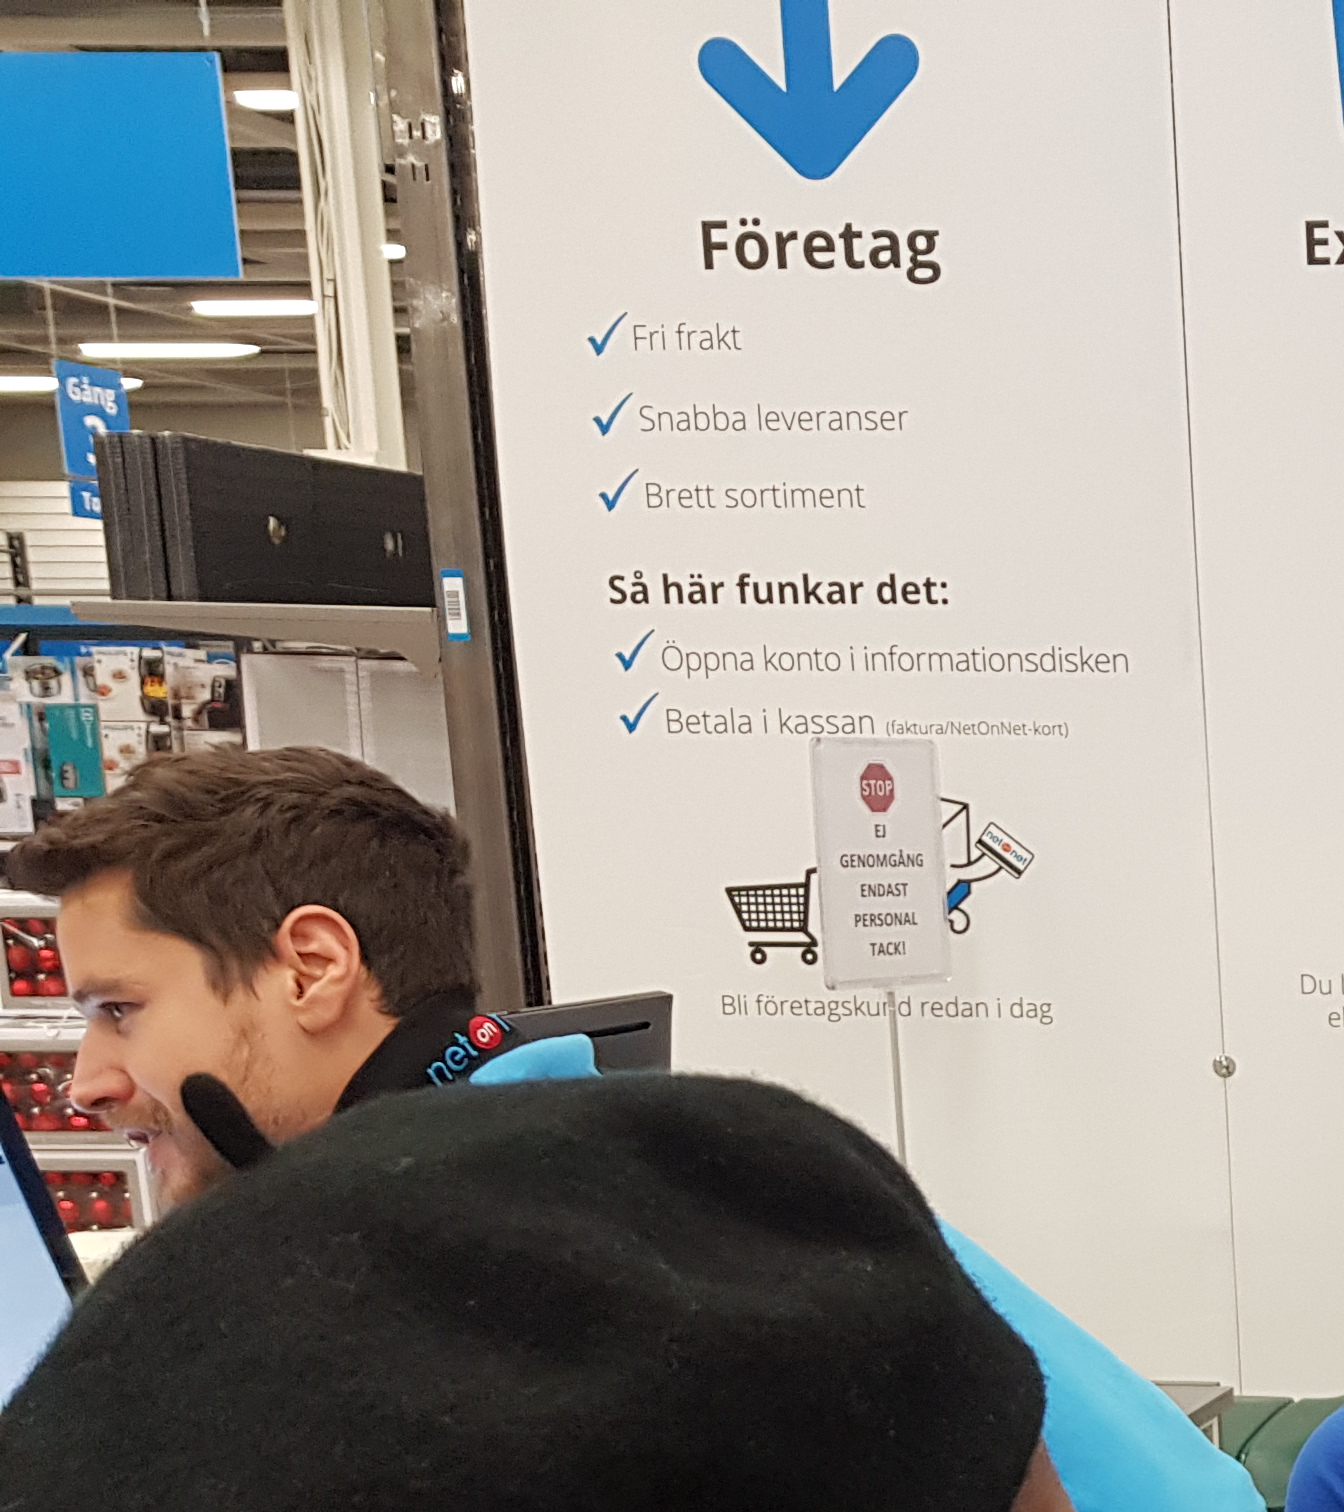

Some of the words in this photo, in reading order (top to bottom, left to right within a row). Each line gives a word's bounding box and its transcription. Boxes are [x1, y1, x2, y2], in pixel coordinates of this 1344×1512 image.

[701, 217, 942, 285] Företag
[633, 323, 666, 351] Fri
[675, 322, 742, 351] frakt
[65, 376, 118, 416] Gång
[639, 403, 747, 433] Snabba
[757, 403, 909, 432] leveranser
[645, 482, 717, 509] Brett
[724, 481, 866, 509] sortiment
[608, 570, 650, 605] Så
[662, 573, 725, 605] här
[735, 573, 864, 605] funkar
[876, 573, 949, 606] det:
[661, 639, 755, 680] Öppna
[763, 644, 841, 672] konto
[849, 645, 855, 672] i
[863, 644, 1129, 674] informationsdisken
[665, 707, 753, 735] Betala
[762, 708, 768, 735] i
[778, 707, 875, 735] kassan
[885, 719, 1069, 739] (faktura/NetOnNet-kort)
[860, 778, 894, 797] STOP
[875, 823, 887, 839] EJ
[840, 849, 924, 869] GENOMGÅNG
[860, 882, 909, 898] ENDAST
[853, 912, 918, 928] PERSONAL
[869, 941, 907, 956] TACK!
[1300, 973, 1332, 996] Du
[721, 993, 749, 1016] Bli
[920, 995, 989, 1018] redan
[996, 997, 1002, 1019] i
[1009, 996, 1054, 1026] dag
[426, 1032, 479, 1087] net
[477, 1022, 498, 1043] on
